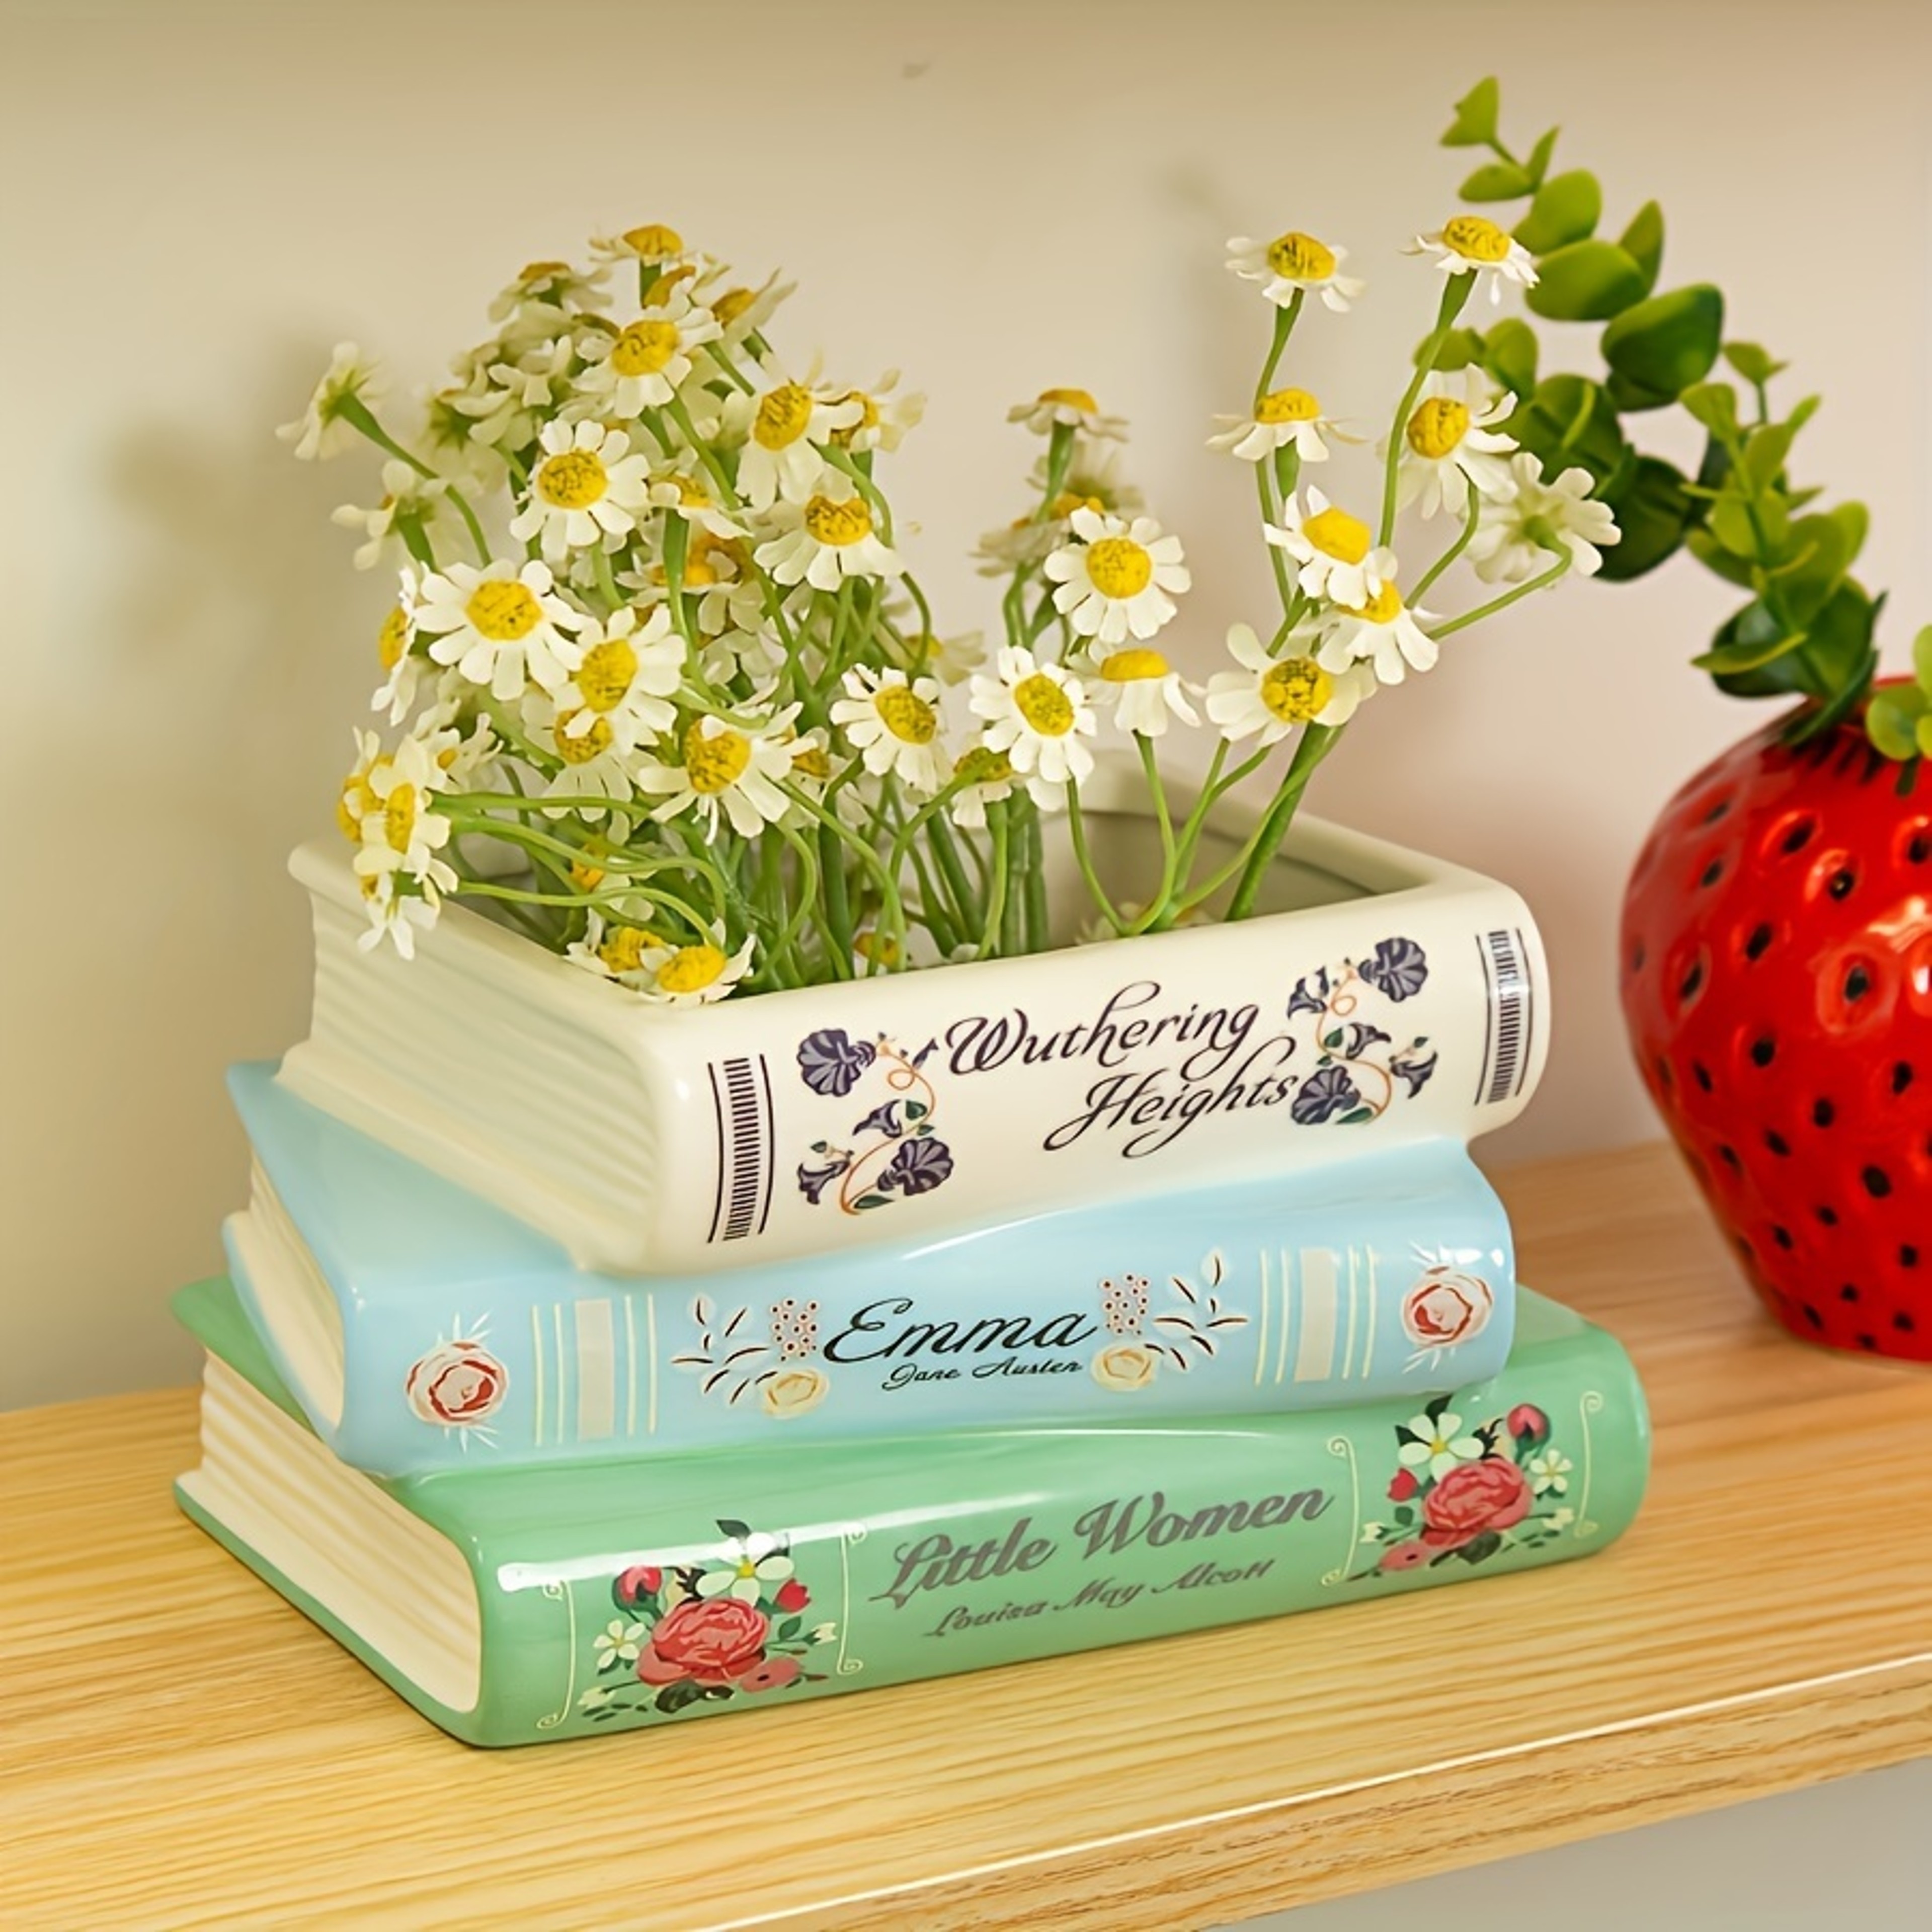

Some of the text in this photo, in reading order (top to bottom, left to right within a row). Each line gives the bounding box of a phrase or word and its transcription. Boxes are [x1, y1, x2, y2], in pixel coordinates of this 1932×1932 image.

[945, 981, 1259, 1082] Wuthering
[1043, 1036, 1297, 1159] Heights
[823, 1298, 1098, 1363] Emma
[881, 1356, 1083, 1391] Jane Austen
[868, 1487, 1336, 1609] Little Women
[922, 1558, 1276, 1637] Louisa May Alcott
